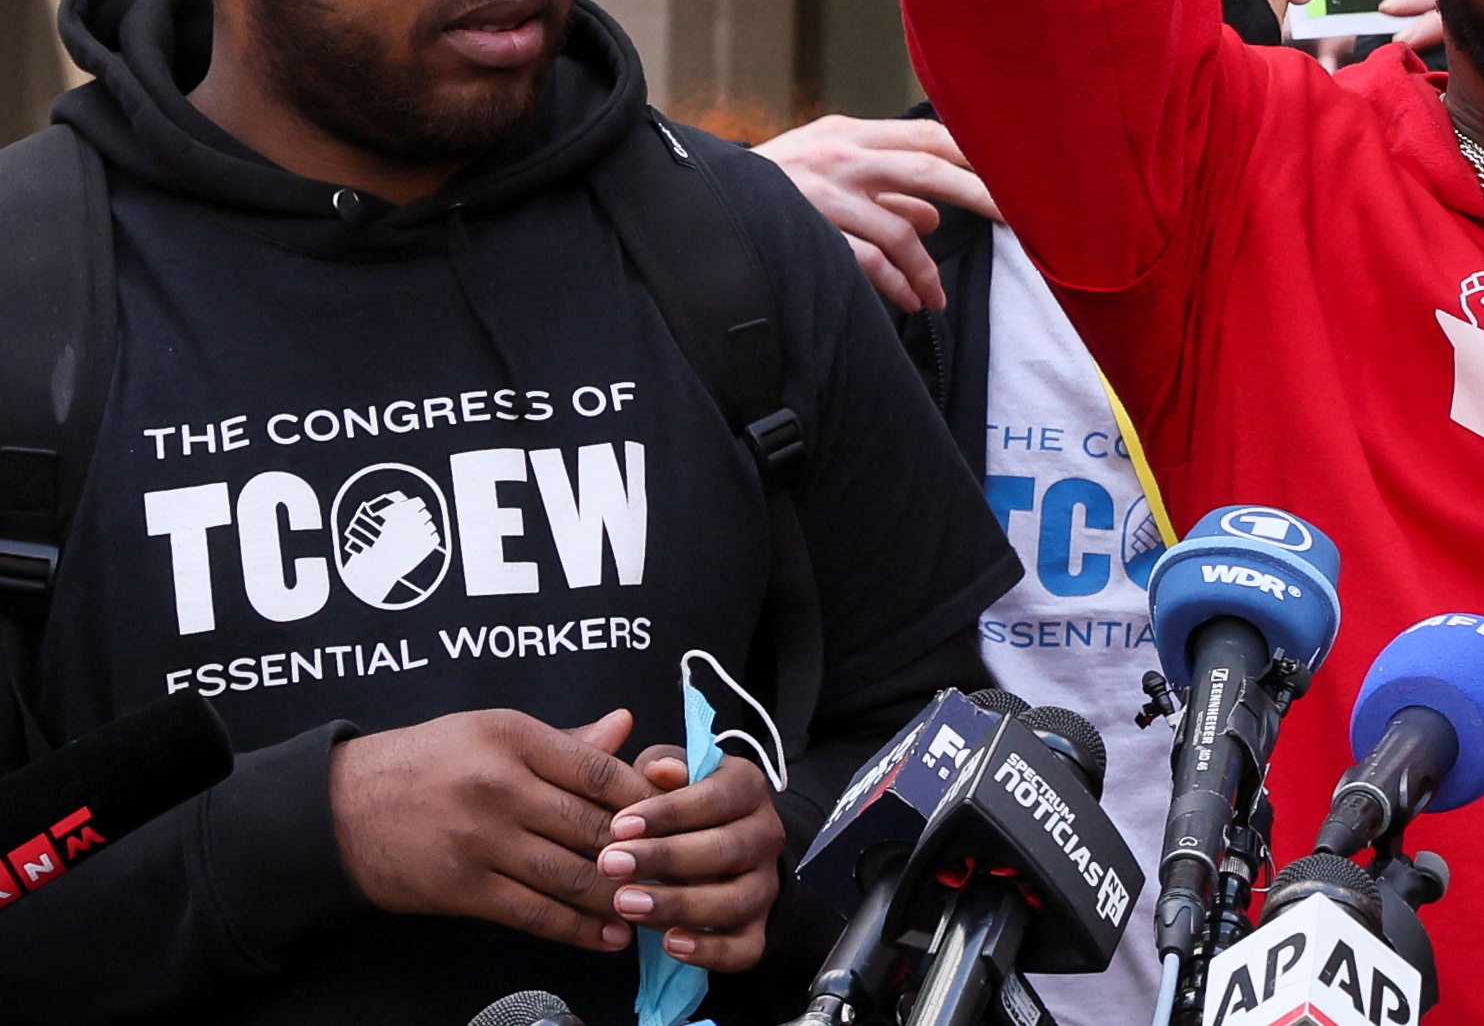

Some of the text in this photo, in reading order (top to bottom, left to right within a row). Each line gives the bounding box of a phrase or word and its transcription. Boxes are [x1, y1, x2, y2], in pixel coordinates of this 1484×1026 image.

[143, 380, 637, 460] THE CONGRESS OF
[165, 616, 653, 698] ESSENTIAL WORKERS
[1201, 682, 1224, 744] SENNHEISER
[1006, 752, 1076, 825] SPECTRUM
[1212, 931, 1307, 1026] AP
[1317, 937, 1411, 1026] AP
